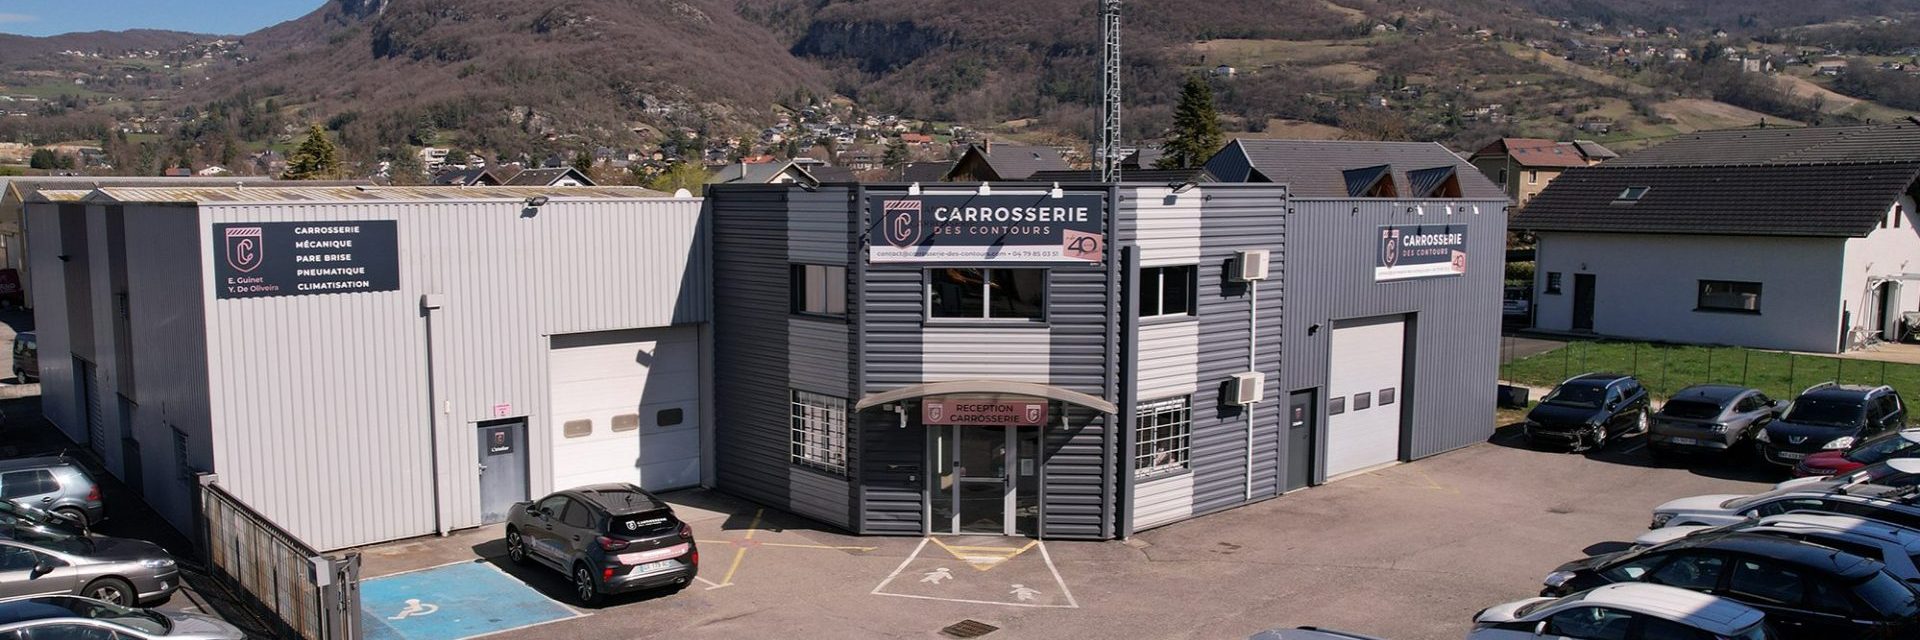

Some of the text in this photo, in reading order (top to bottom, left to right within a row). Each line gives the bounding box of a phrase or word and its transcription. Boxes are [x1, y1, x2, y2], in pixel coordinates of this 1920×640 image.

[934, 207, 1088, 222] CARROSSERIE
[295, 226, 360, 235] CARROSSERIE
[934, 226, 1051, 235] DES CONTOURS
[296, 239, 353, 249] MÉCANIQUE
[1403, 233, 1462, 247] CARROSSERIE
[1067, 236, 1097, 254] 40
[1403, 248, 1449, 257] DES CONTOURS
[296, 253, 352, 263] PARE BRISE
[297, 267, 365, 277] PNEUMATIQUE
[237, 276, 264, 284] Guinet
[250, 284, 279, 292] Oliveira
[297, 280, 370, 291] CLIMATISATION
[956, 404, 1014, 413] RECEPTION
[949, 414, 1020, 423] CARROSSERIE
